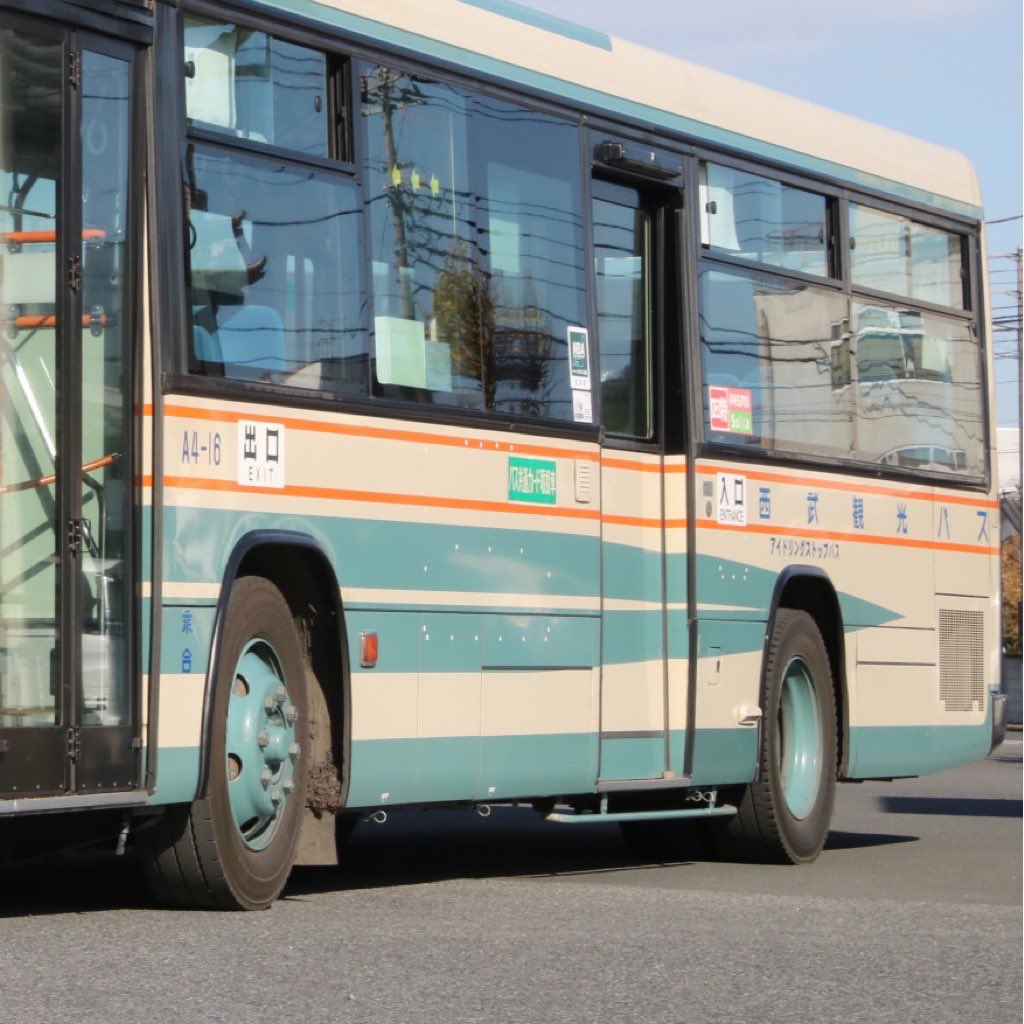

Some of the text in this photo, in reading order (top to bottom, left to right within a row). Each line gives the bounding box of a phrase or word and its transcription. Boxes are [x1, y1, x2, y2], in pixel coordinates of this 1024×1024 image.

[181, 430, 222, 466] A4-16
[243, 424, 279, 464] 出口
[248, 465, 274, 483] EXIT
[719, 476, 744, 506] 入口
[758, 486, 989, 543] 西武観光バス
